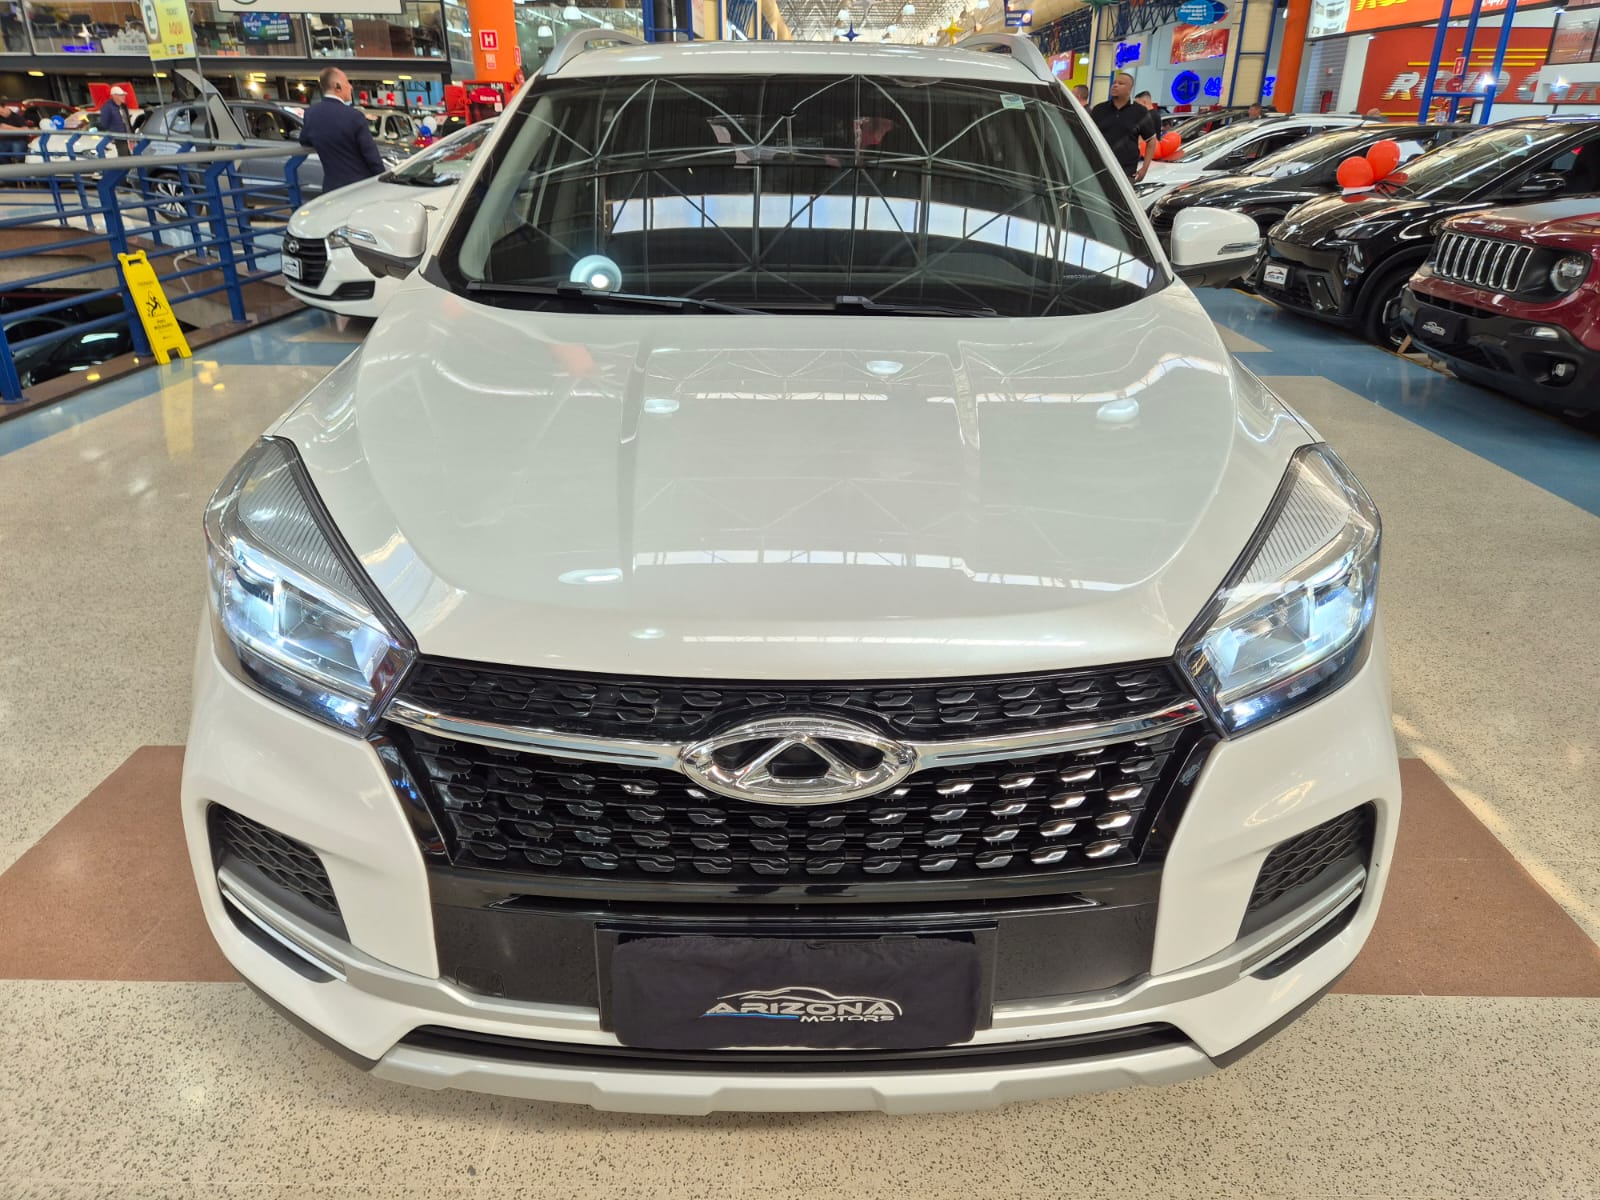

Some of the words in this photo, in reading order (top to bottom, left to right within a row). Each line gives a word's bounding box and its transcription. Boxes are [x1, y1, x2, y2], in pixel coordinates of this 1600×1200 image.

[484, 33, 495, 47] H
[704, 1002, 896, 1016] ARIZONA
[799, 1015, 896, 1023] MOTORS
